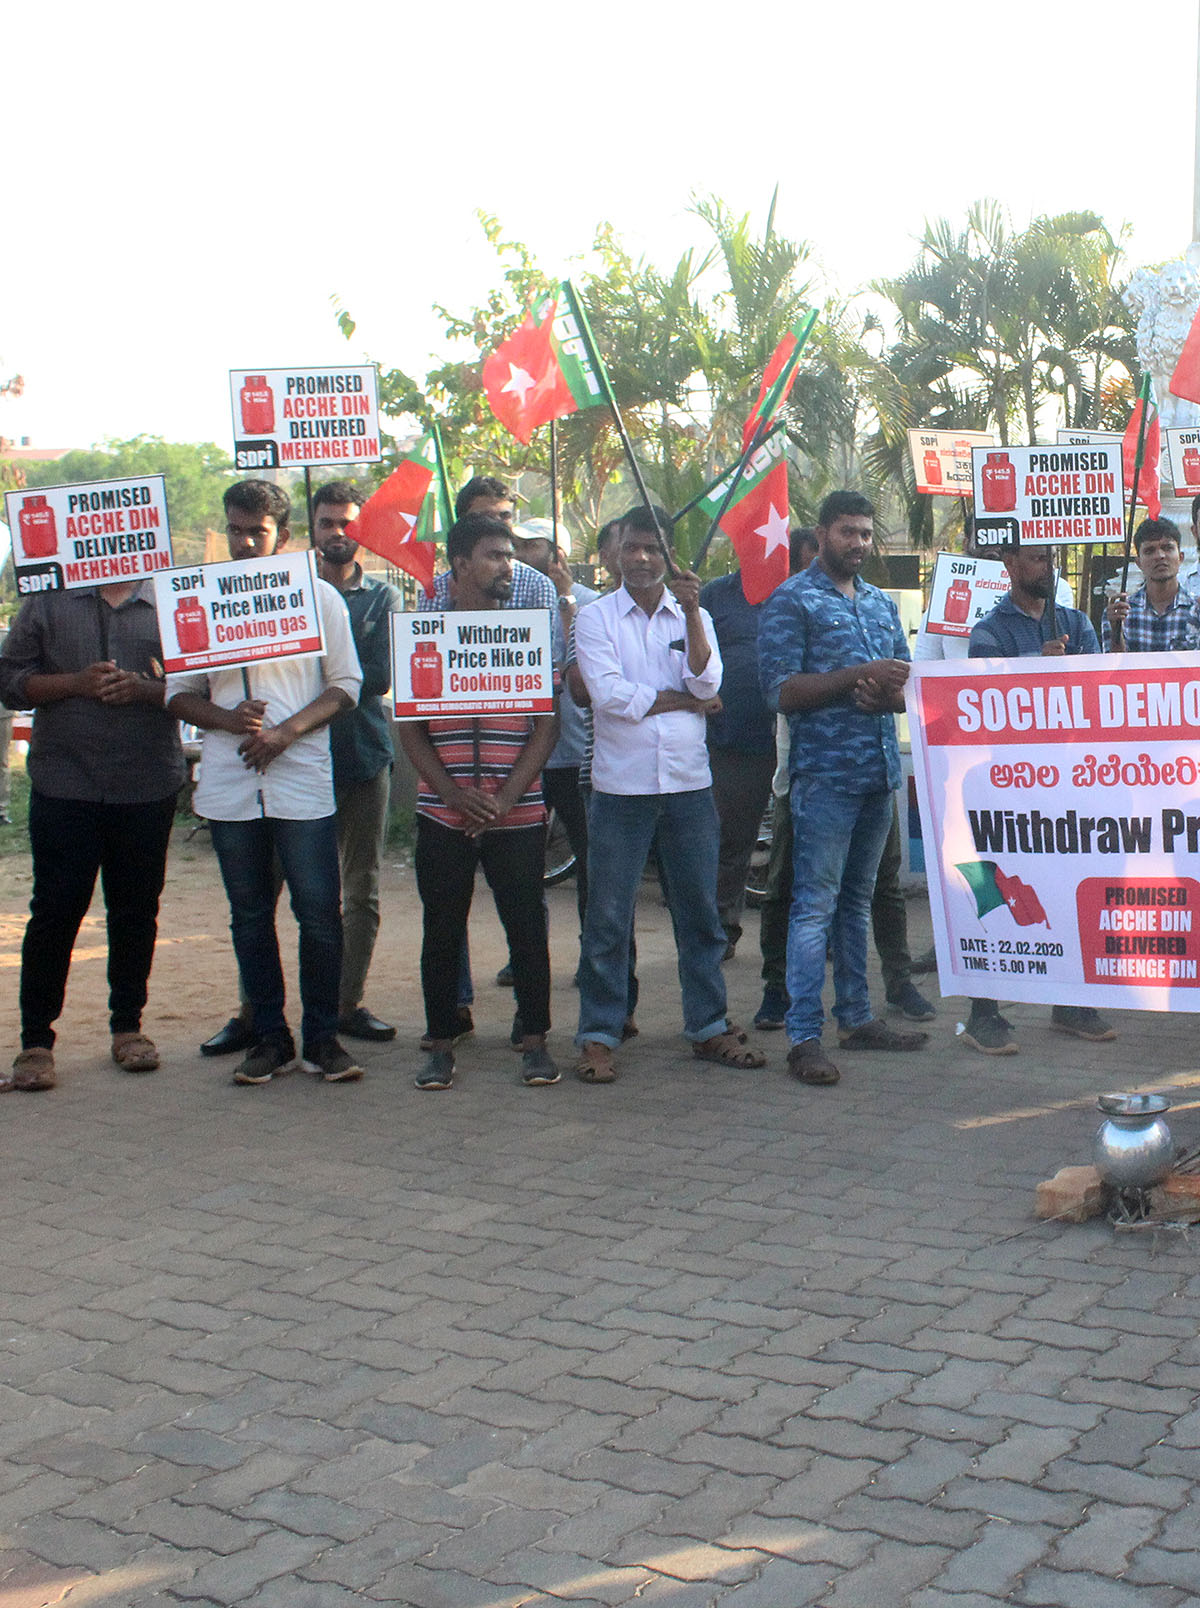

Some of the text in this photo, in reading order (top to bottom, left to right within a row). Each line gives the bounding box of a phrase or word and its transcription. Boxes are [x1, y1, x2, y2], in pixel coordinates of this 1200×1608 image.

[287, 375, 363, 395] PROMISED
[283, 395, 370, 419] ACCHE DIN
[290, 418, 366, 439] DELIVERED
[281, 438, 378, 461] MEHENGE DIN
[1029, 452, 1108, 473] PROMISED
[1024, 472, 1115, 496] ACCHE DIN
[68, 486, 151, 513] PROMISED
[1031, 497, 1110, 518] DELIVERED
[66, 510, 127, 539] ACCHE
[130, 506, 160, 532] DIN
[1021, 517, 1122, 539] MEHENGE DIN
[74, 531, 156, 560] DELIVERED
[65, 551, 170, 583] MEHENGE DIN
[217, 570, 290, 596] Withdraw
[211, 600, 250, 621] Price
[254, 593, 286, 614] Hike
[290, 589, 304, 609] of
[216, 615, 307, 643] Cooking gas
[457, 625, 531, 645] Withdraw
[448, 649, 487, 668] Price
[491, 648, 523, 668] Hike
[527, 647, 542, 666] of
[450, 672, 542, 693] Cooking gas
[957, 686, 1091, 732] SOCIAL
[990, 759, 1059, 788] ಅನಿಲ
[968, 809, 1152, 854] Withdraw
[1105, 887, 1187, 906] PROMISED
[1099, 909, 1192, 932] ACCHE DIN
[960, 938, 988, 953] DATE
[998, 940, 1064, 957] 22.02.2020
[1105, 936, 1186, 955] DELIVERED
[962, 956, 990, 971] TIME
[999, 959, 1025, 974] 5.00
[1028, 960, 1048, 975] PM
[1095, 957, 1197, 979] MEHENGE DIN
